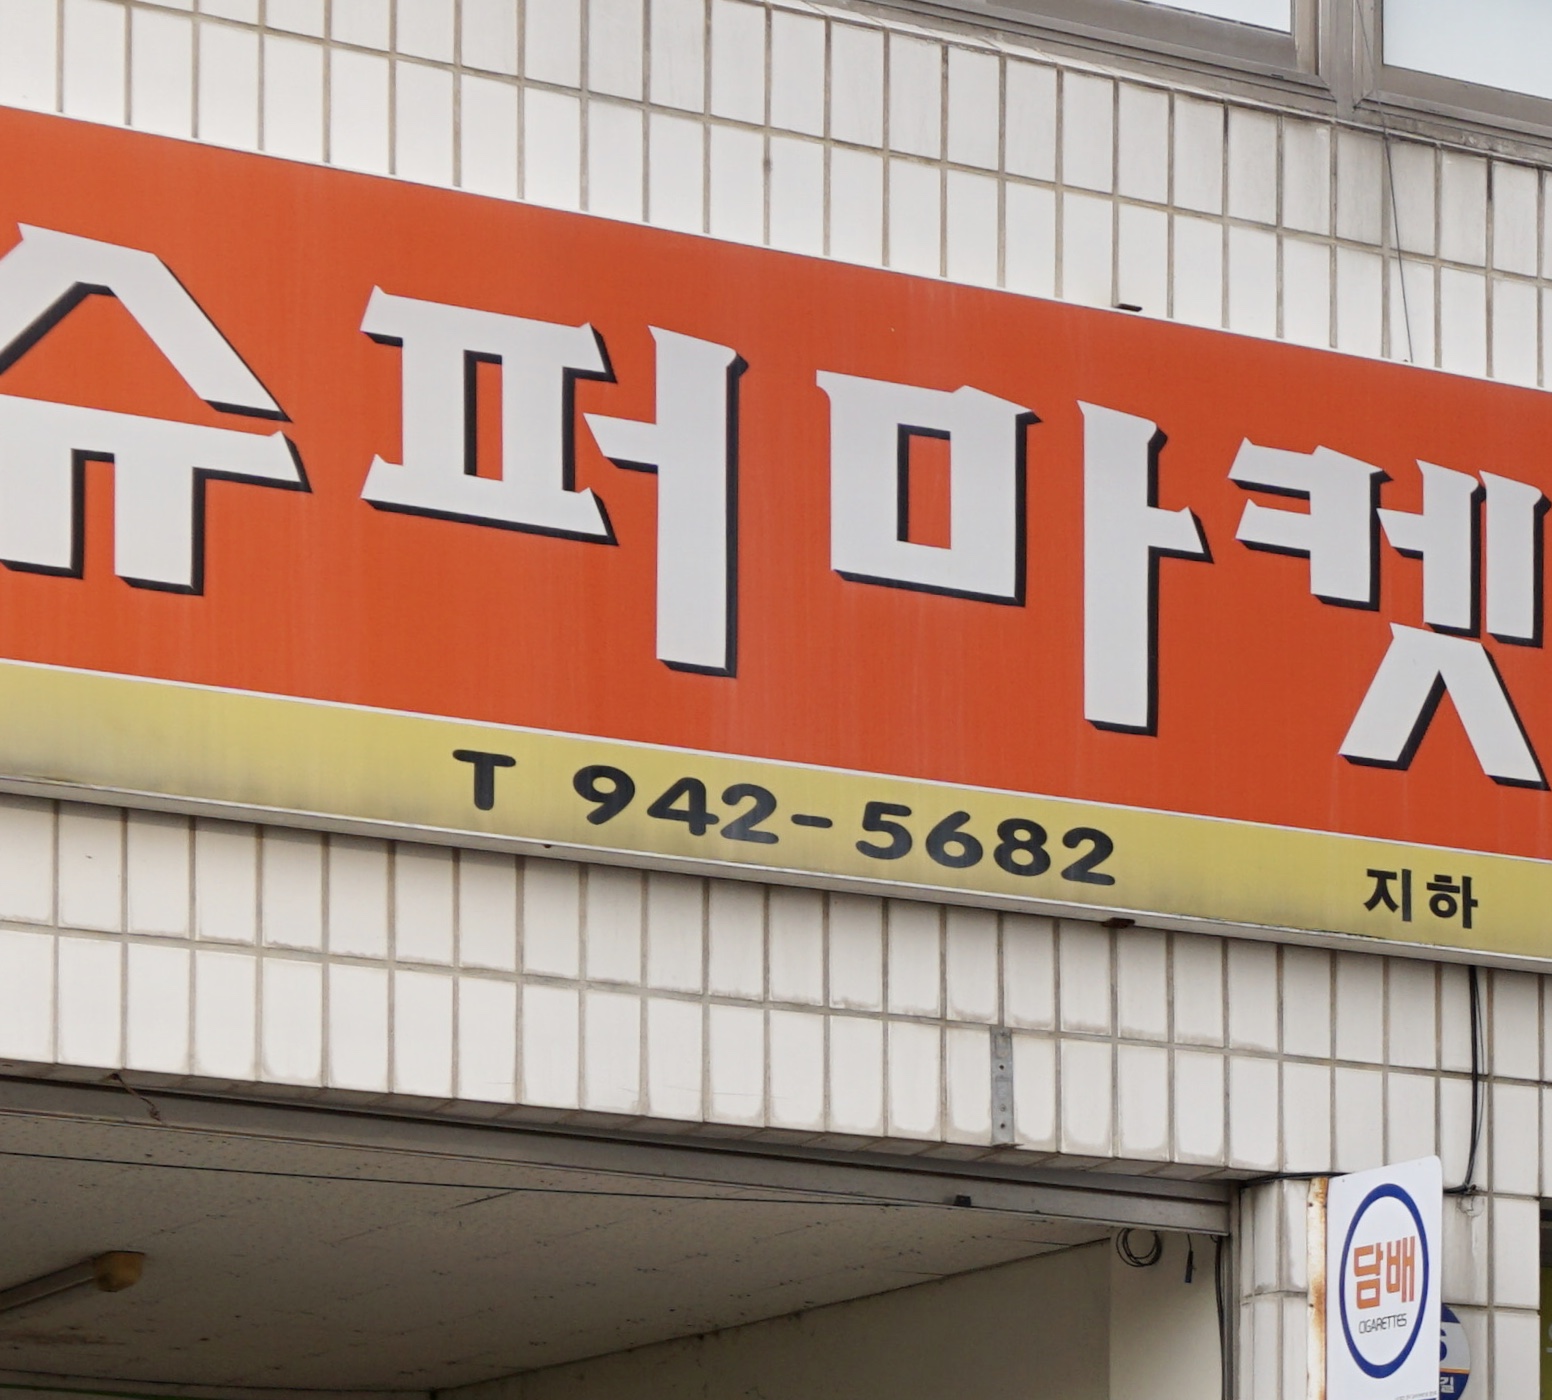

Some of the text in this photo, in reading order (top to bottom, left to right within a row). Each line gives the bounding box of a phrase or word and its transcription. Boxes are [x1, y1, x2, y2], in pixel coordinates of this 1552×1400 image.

[0, 223, 1552, 791] 슈퍼마켓
[453, 749, 1116, 887] T 942-5682
[1363, 867, 1479, 930] 지하
[1353, 1235, 1417, 1310] 담배
[1358, 1313, 1408, 1335] CIGARETTES
